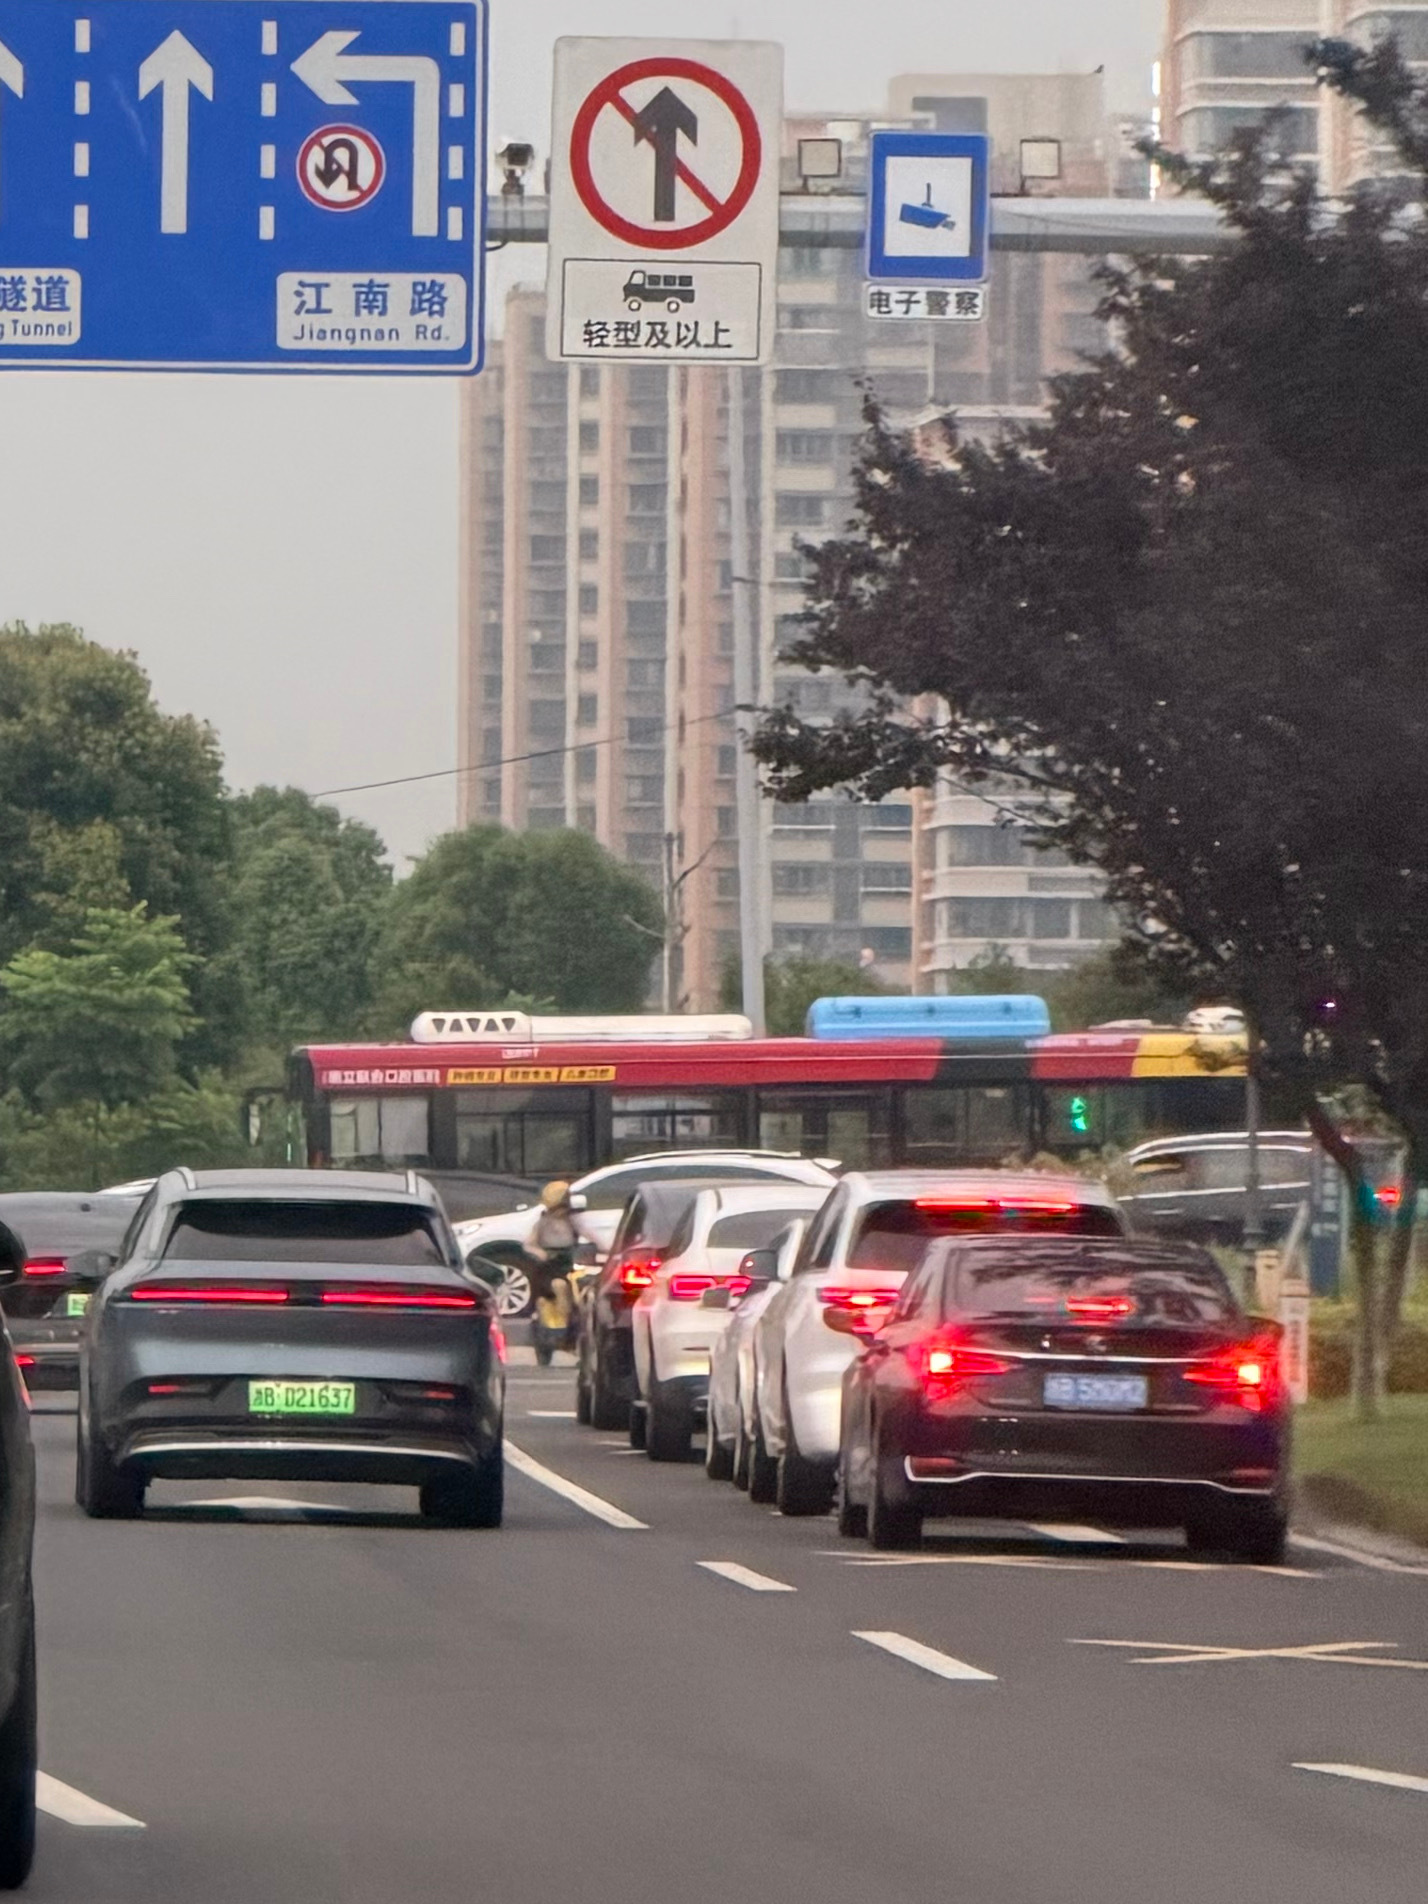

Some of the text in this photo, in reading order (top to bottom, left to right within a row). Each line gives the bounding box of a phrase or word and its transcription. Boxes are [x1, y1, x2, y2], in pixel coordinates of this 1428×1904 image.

[293, 278, 449, 318] 江南路
[868, 288, 981, 316] 电子警察
[10, 318, 73, 337] Tunnel
[292, 322, 451, 346] Jiangnan Rd.
[582, 318, 733, 349] 轻型及以上
